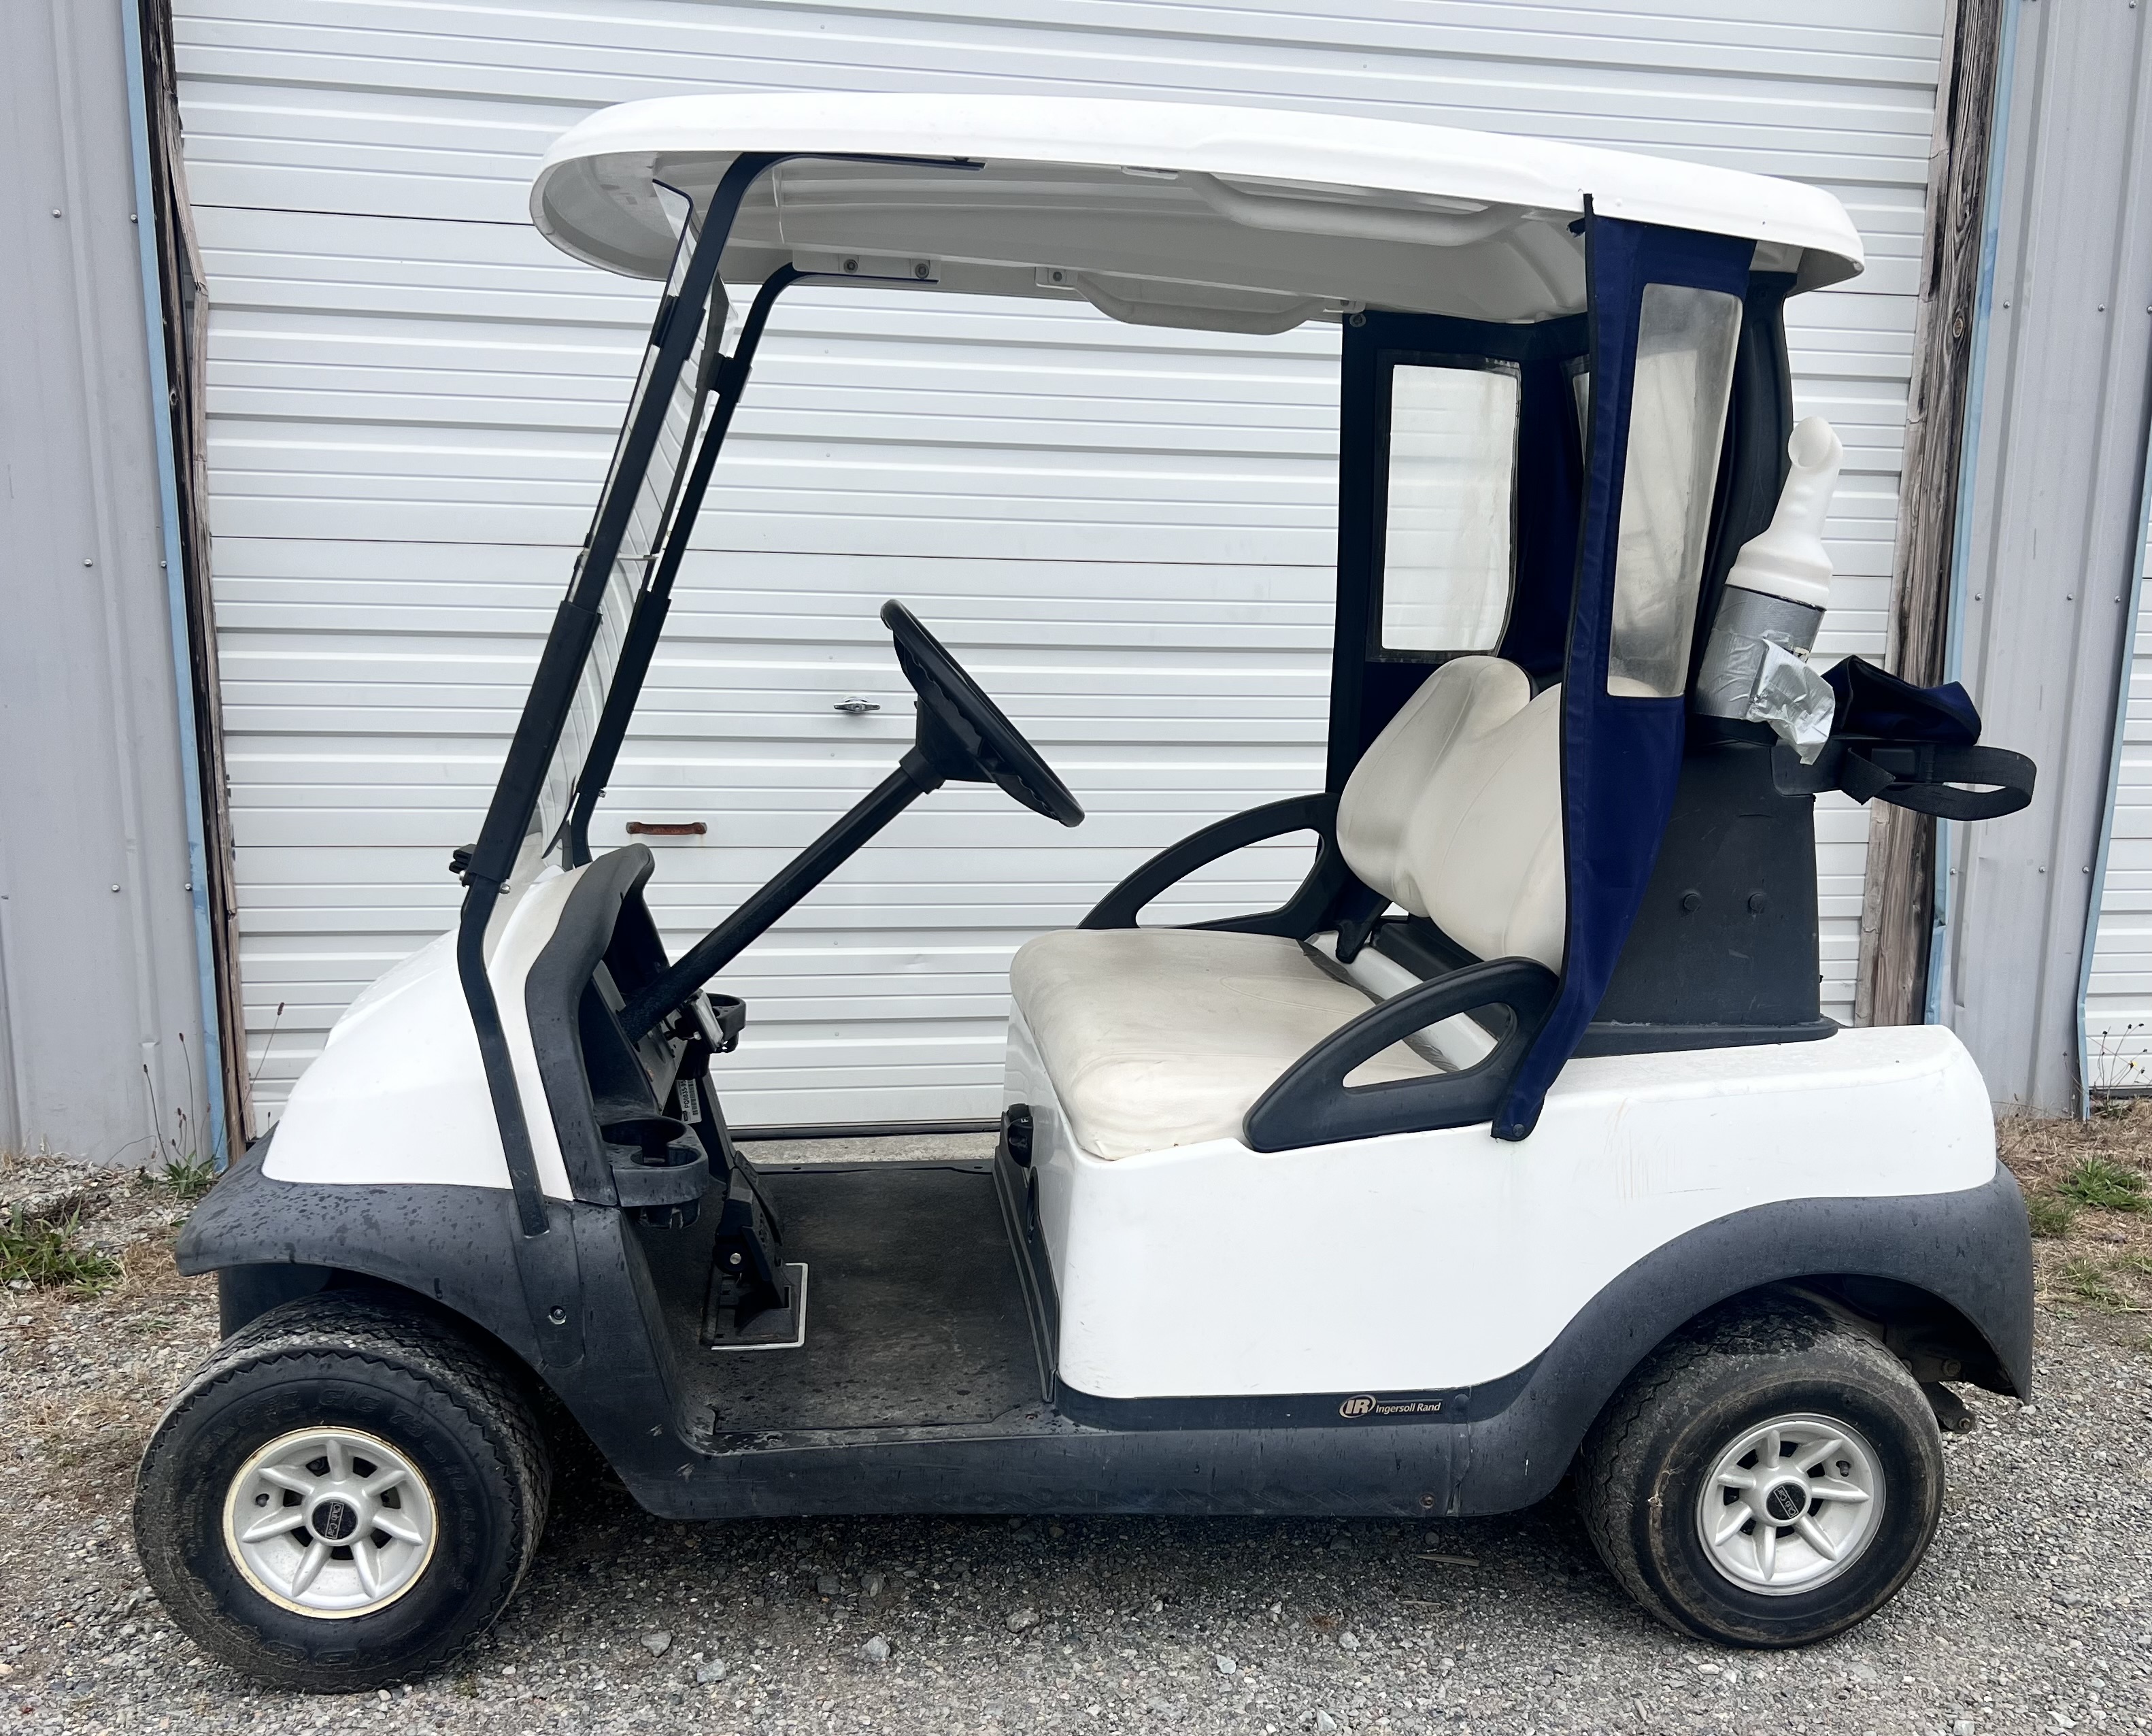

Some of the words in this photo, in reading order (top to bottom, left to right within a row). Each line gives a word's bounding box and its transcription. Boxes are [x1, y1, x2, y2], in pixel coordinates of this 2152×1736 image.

[1345, 1399, 1370, 1414] IR
[1375, 1403, 1415, 1415] Ingersoll
[1417, 1402, 1441, 1412] Rand
[1777, 1489, 1787, 1501] Car
[331, 1504, 341, 1521] Club
[1785, 1501, 1796, 1516] Club
[327, 1522, 338, 1537] Car
